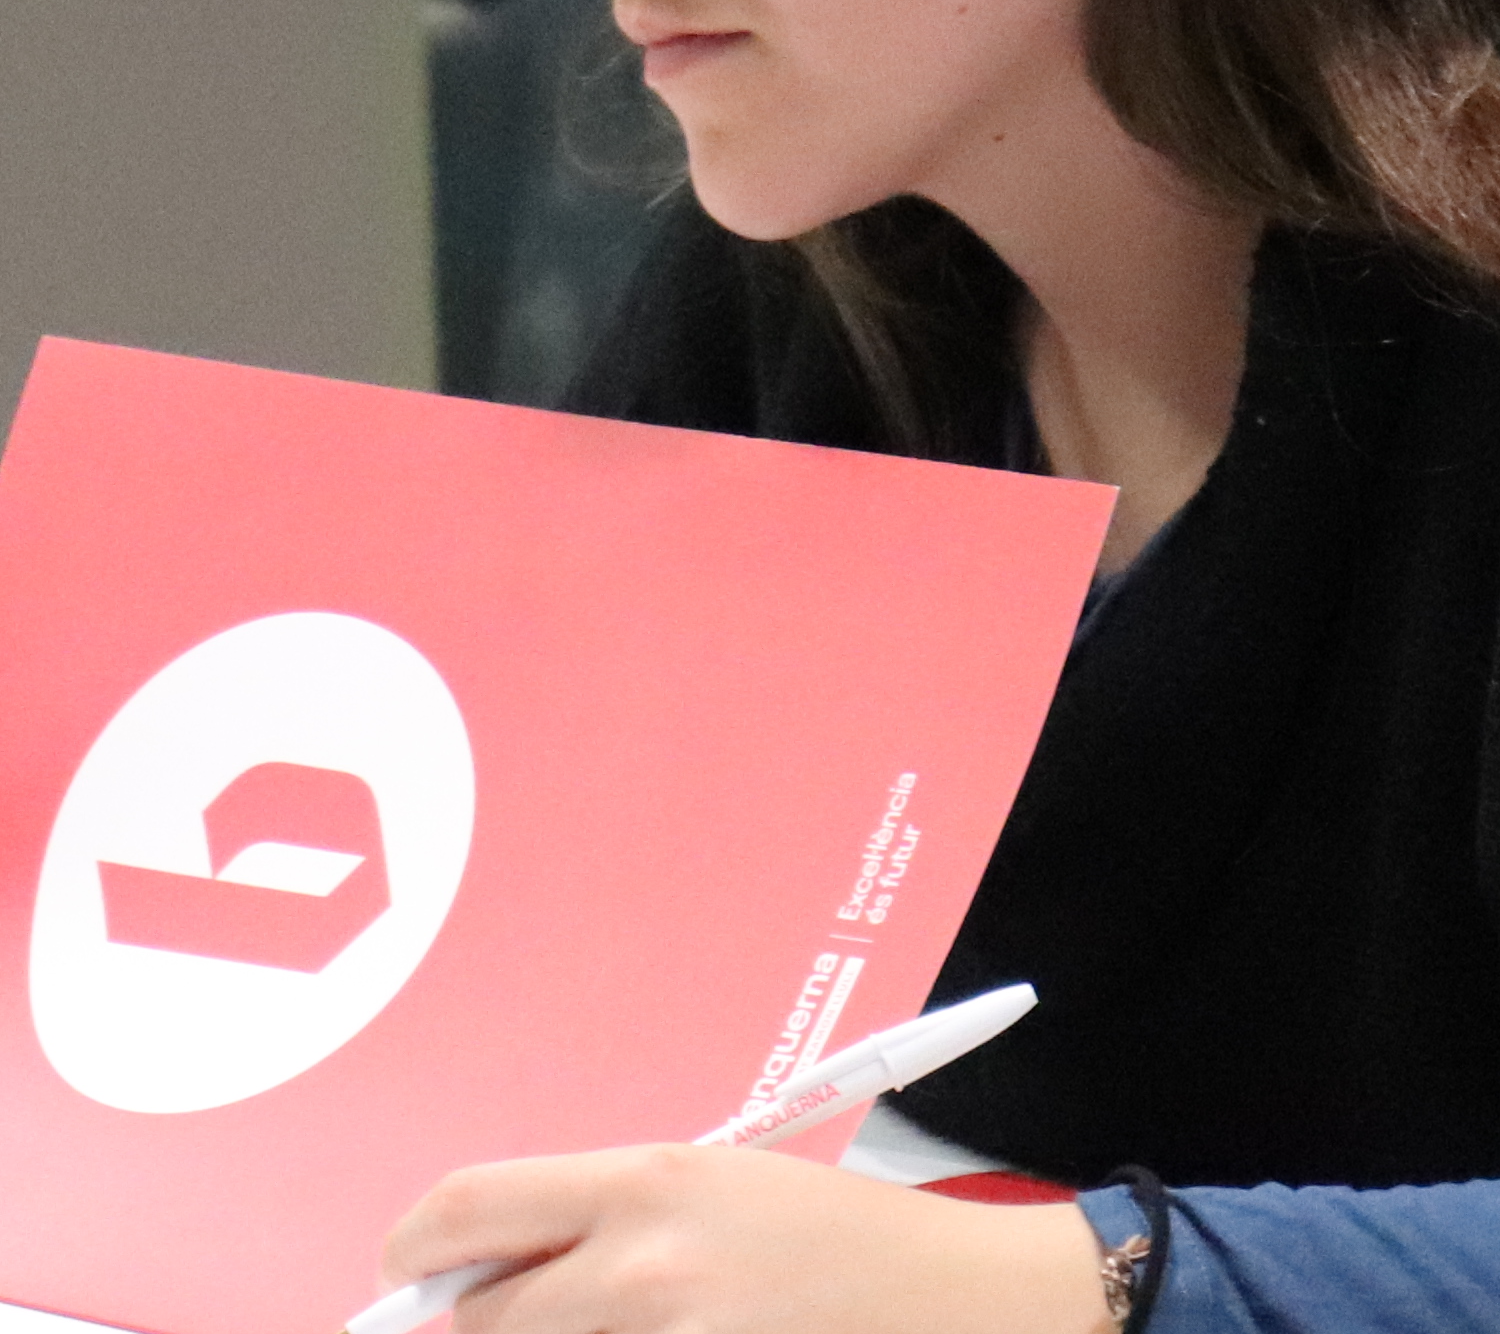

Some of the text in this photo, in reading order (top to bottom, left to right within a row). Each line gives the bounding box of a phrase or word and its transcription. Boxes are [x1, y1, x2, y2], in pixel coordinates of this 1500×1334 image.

[866, 824, 921, 924] és futur
[726, 952, 840, 1129] anquerna
[714, 1082, 841, 1148] ANQUERNA
